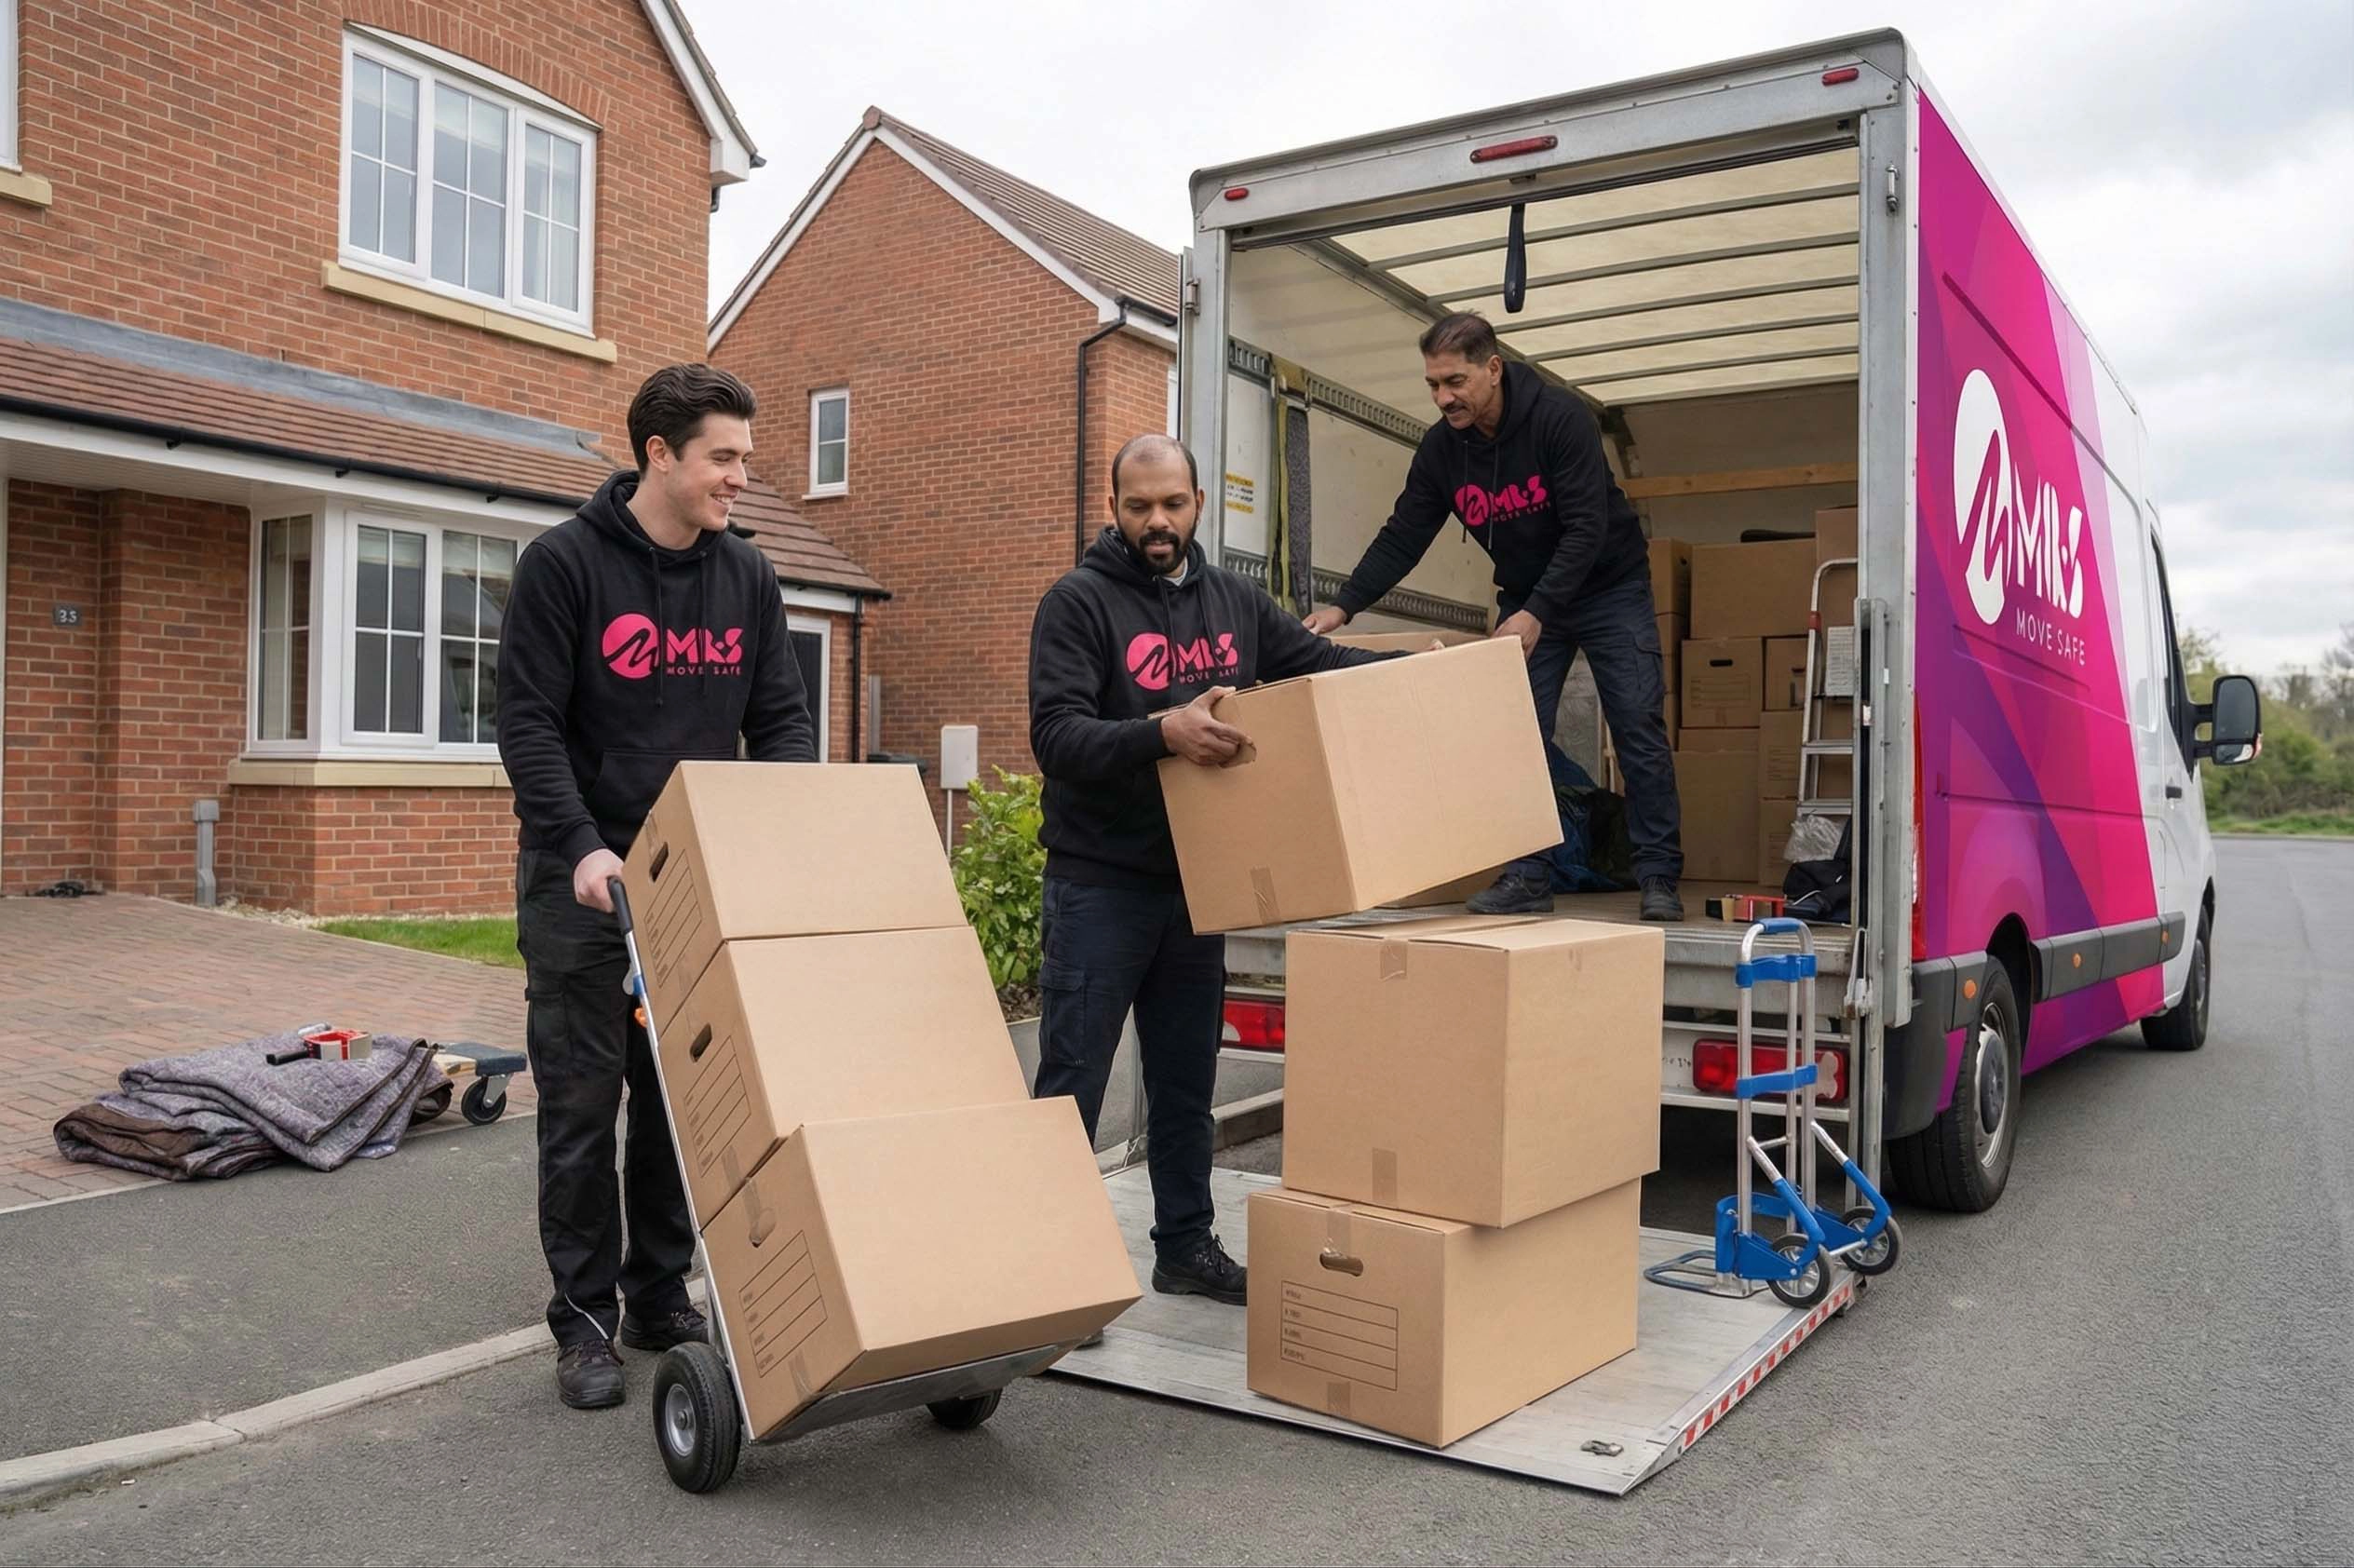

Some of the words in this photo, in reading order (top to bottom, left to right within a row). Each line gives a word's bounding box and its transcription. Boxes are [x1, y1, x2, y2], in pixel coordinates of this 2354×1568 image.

[2016, 606, 2053, 652] MOVE
[2056, 628, 2086, 667] SAFE
[667, 667, 704, 676] MOVE
[713, 666, 742, 676] SAFE
[1179, 671, 1210, 684] MOVE
